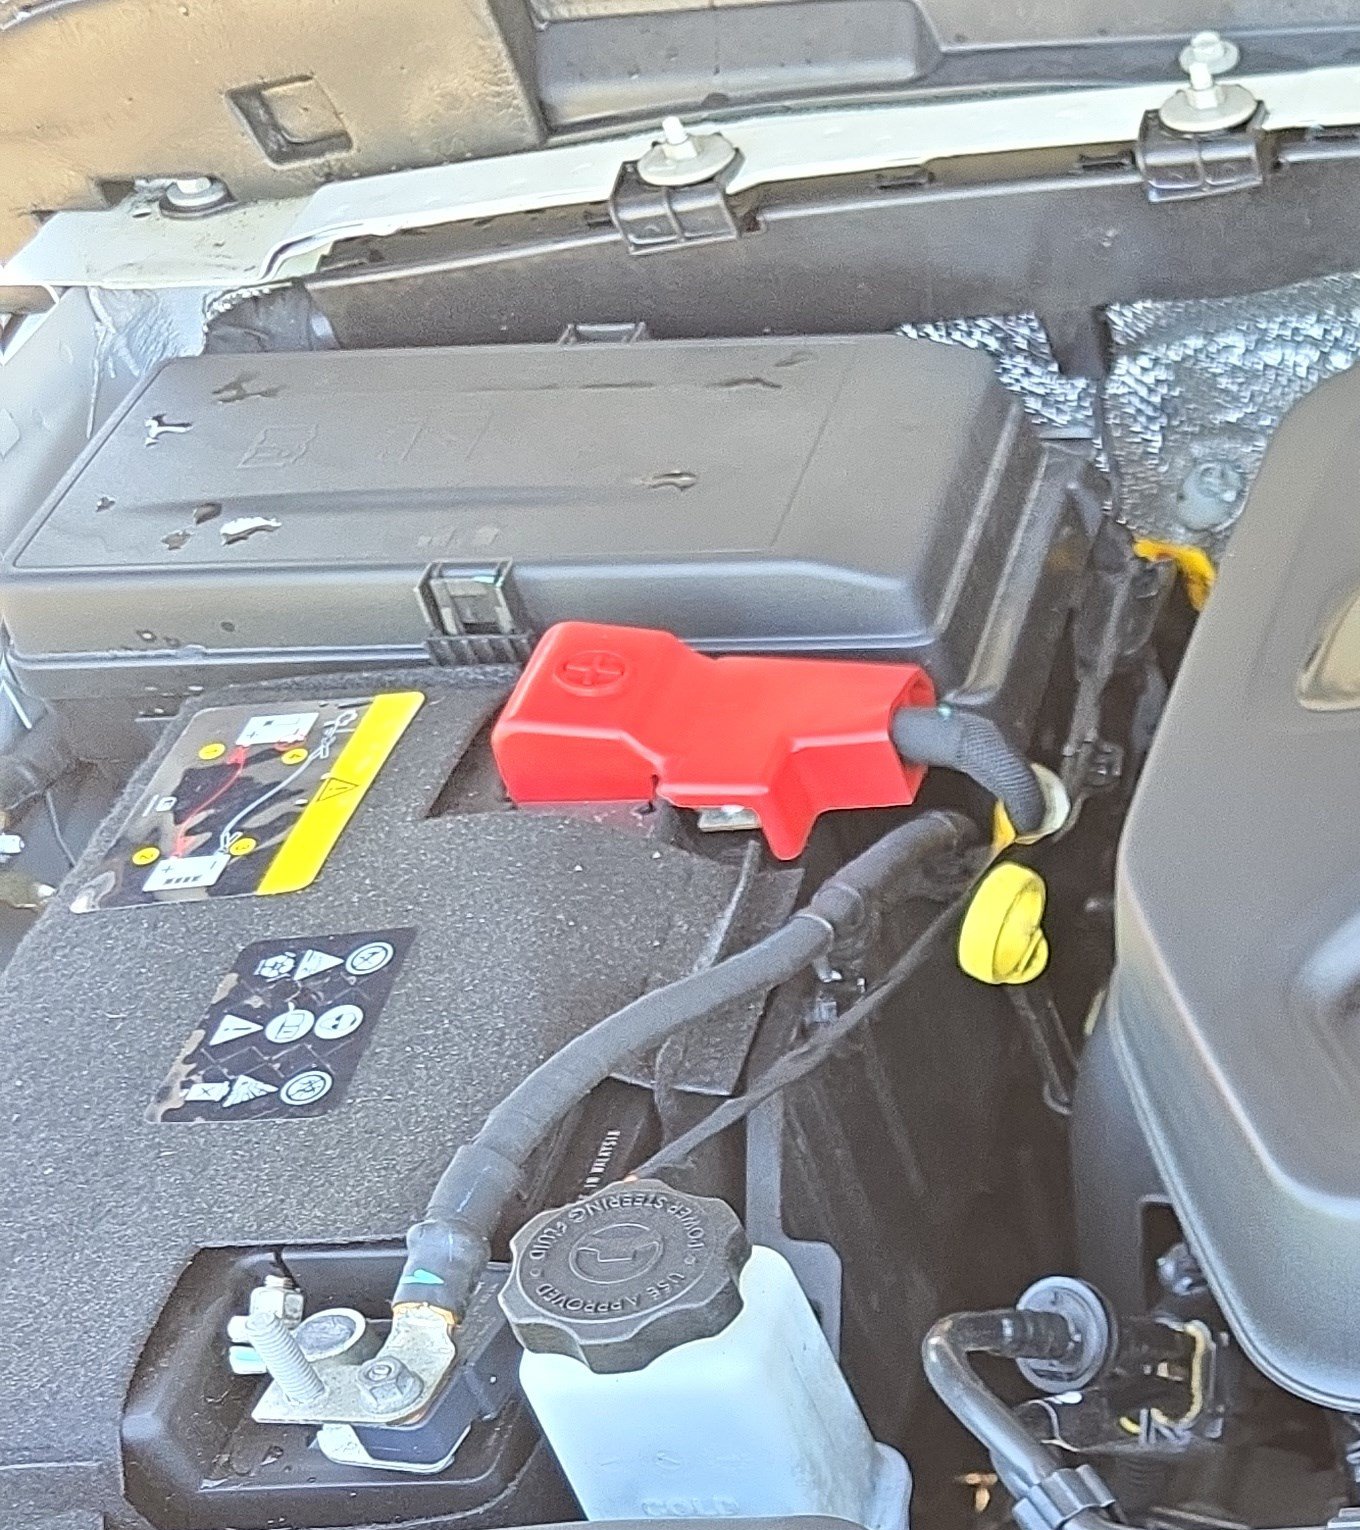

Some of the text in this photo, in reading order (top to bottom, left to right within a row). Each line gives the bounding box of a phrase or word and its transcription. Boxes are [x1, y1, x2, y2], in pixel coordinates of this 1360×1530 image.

[529, 1193, 705, 1261] POWER STEERING FLUID
[536, 1272, 685, 1314] USE APPROVED
